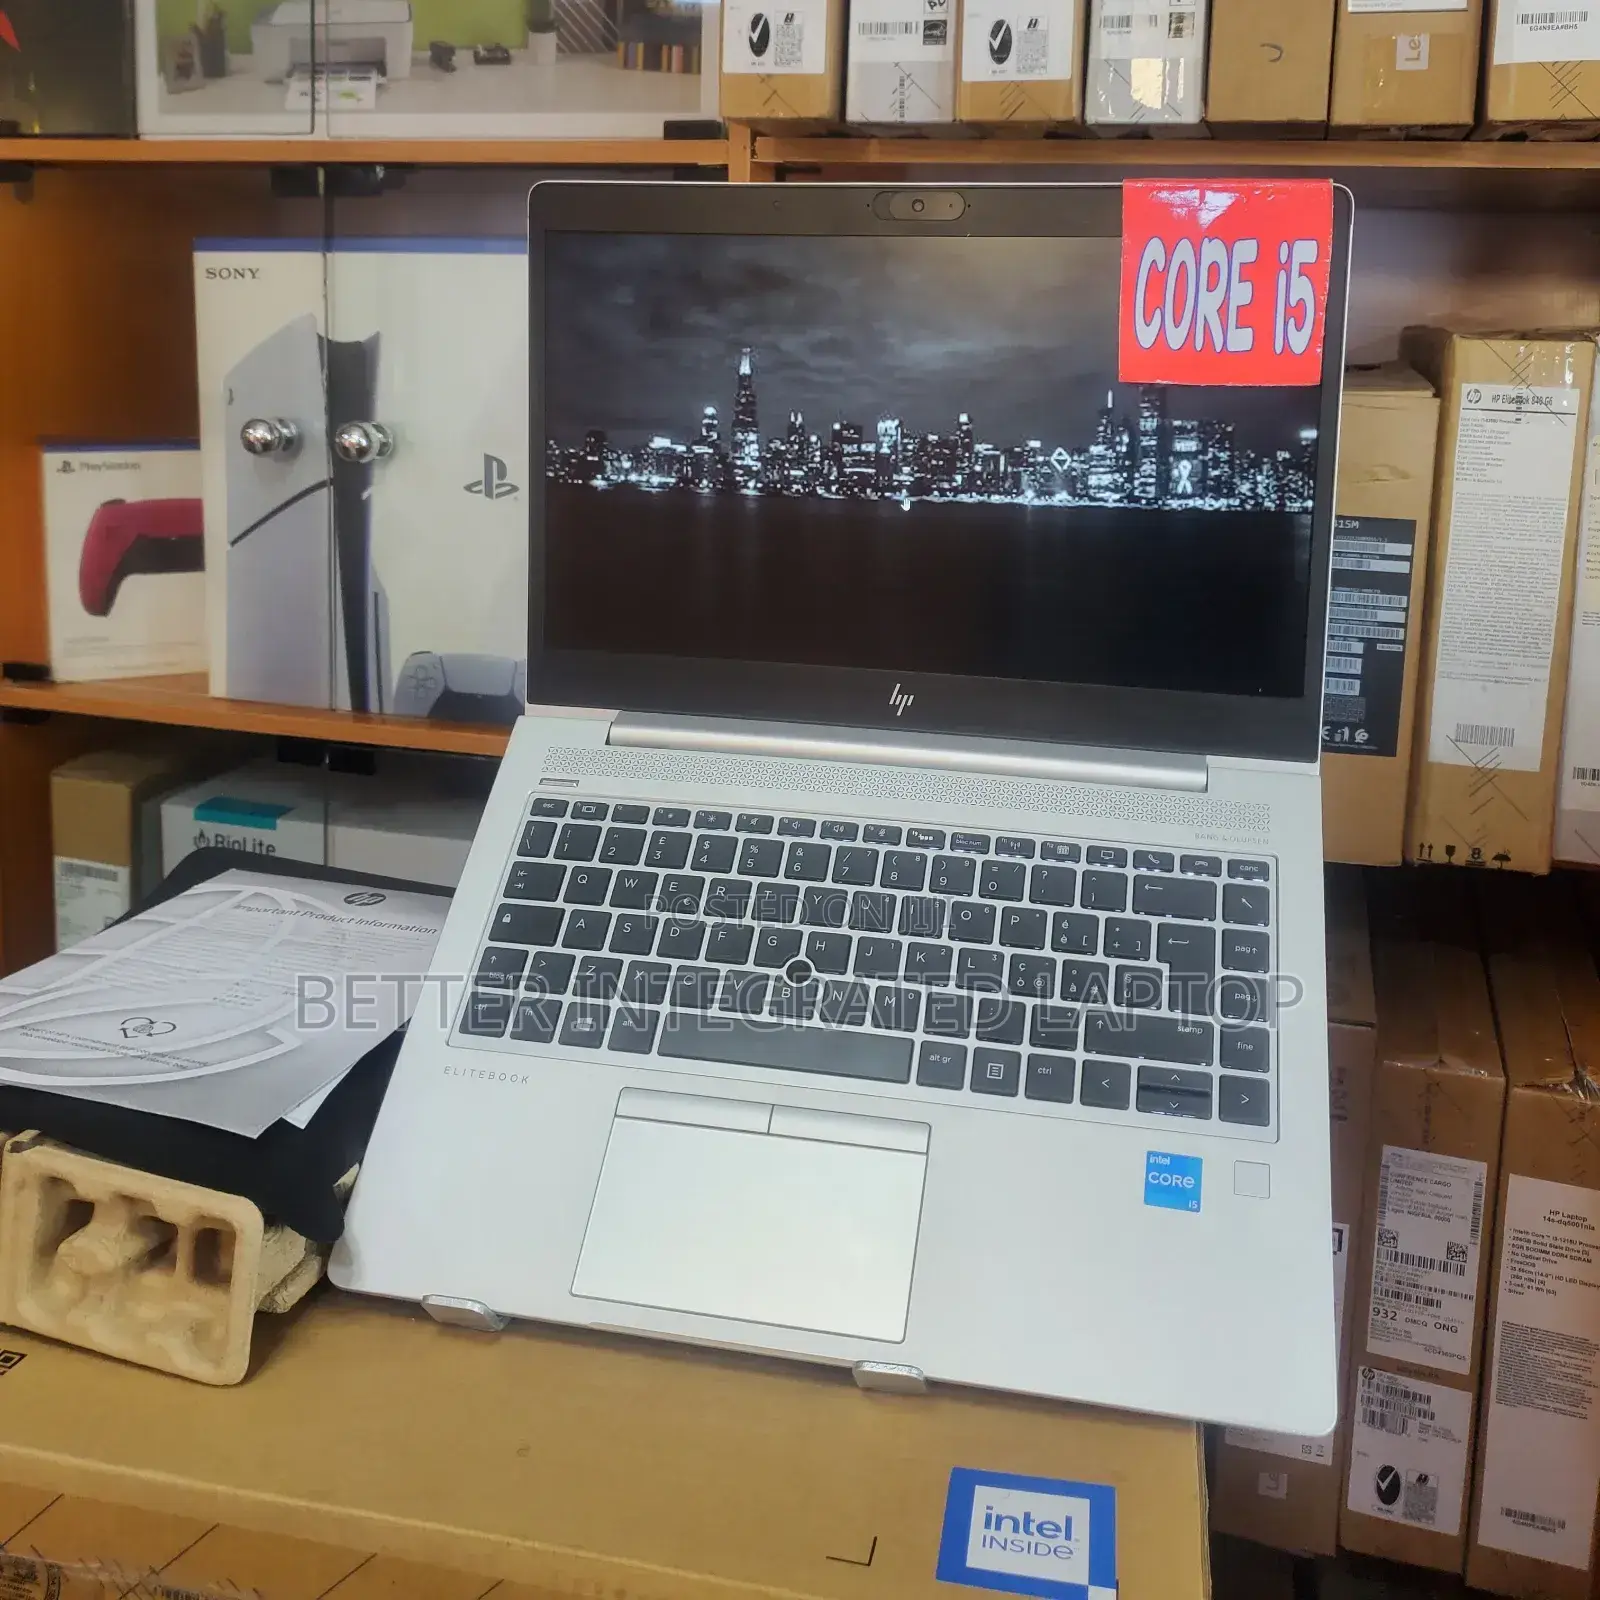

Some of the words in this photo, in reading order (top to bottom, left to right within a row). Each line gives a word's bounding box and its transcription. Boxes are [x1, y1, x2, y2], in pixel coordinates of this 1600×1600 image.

[205, 266, 259, 280] SONY
[1134, 236, 1259, 354] CORE
[1273, 239, 1319, 355] i5
[1491, 394, 1501, 403] HP
[577, 874, 588, 884] Q
[624, 878, 639, 889] W
[669, 882, 678, 892] E
[716, 886, 726, 897] R
[764, 890, 772, 900] T
[813, 894, 822, 904] Y
[233, 904, 300, 917] Important
[300, 910, 352, 924] Product
[355, 918, 438, 935] Information
[576, 918, 586, 929] A
[1010, 916, 1020, 926] P
[622, 922, 632, 933] S
[670, 928, 680, 937] D
[718, 932, 727, 942] F
[767, 936, 778, 946] G
[816, 940, 826, 951] H
[1235, 946, 1250, 954] pag
[865, 946, 874, 956] J
[916, 952, 926, 962] K
[968, 958, 976, 968] L
[586, 966, 596, 976] Z
[634, 970, 645, 981] X
[683, 975, 692, 986] C
[734, 980, 744, 990] V
[781, 987, 790, 998] B
[832, 991, 843, 1001] N
[1234, 993, 1250, 1001] pag
[884, 996, 896, 1007] M
[1237, 1042, 1254, 1050] fine
[930, 1054, 941, 1062] alt
[942, 1056, 952, 1065] gr
[443, 1065, 530, 1084] ELITEBOOK
[1038, 1066, 1052, 1075] ctrl
[1150, 1155, 1170, 1166] intel
[1389, 1172, 1428, 1184] CONFIDENCE
[1430, 1179, 1452, 1188] CARGO
[1549, 1209, 1560, 1217] HP
[1562, 1212, 1588, 1222] Laptop
[1532, 1239, 1548, 1247] Solid
[1565, 1246, 1581, 1254] Drive
[1542, 1257, 1558, 1265] Drive
[1569, 1254, 1592, 1264] SDRAM
[1565, 1277, 1578, 1285] LED
[1508, 1288, 1524, 1296] Silver
[1372, 1306, 1398, 1322] 932
[1405, 1316, 1428, 1328] DMCQ
[1434, 1321, 1458, 1334] ONG
[983, 1505, 1073, 1542] intel
